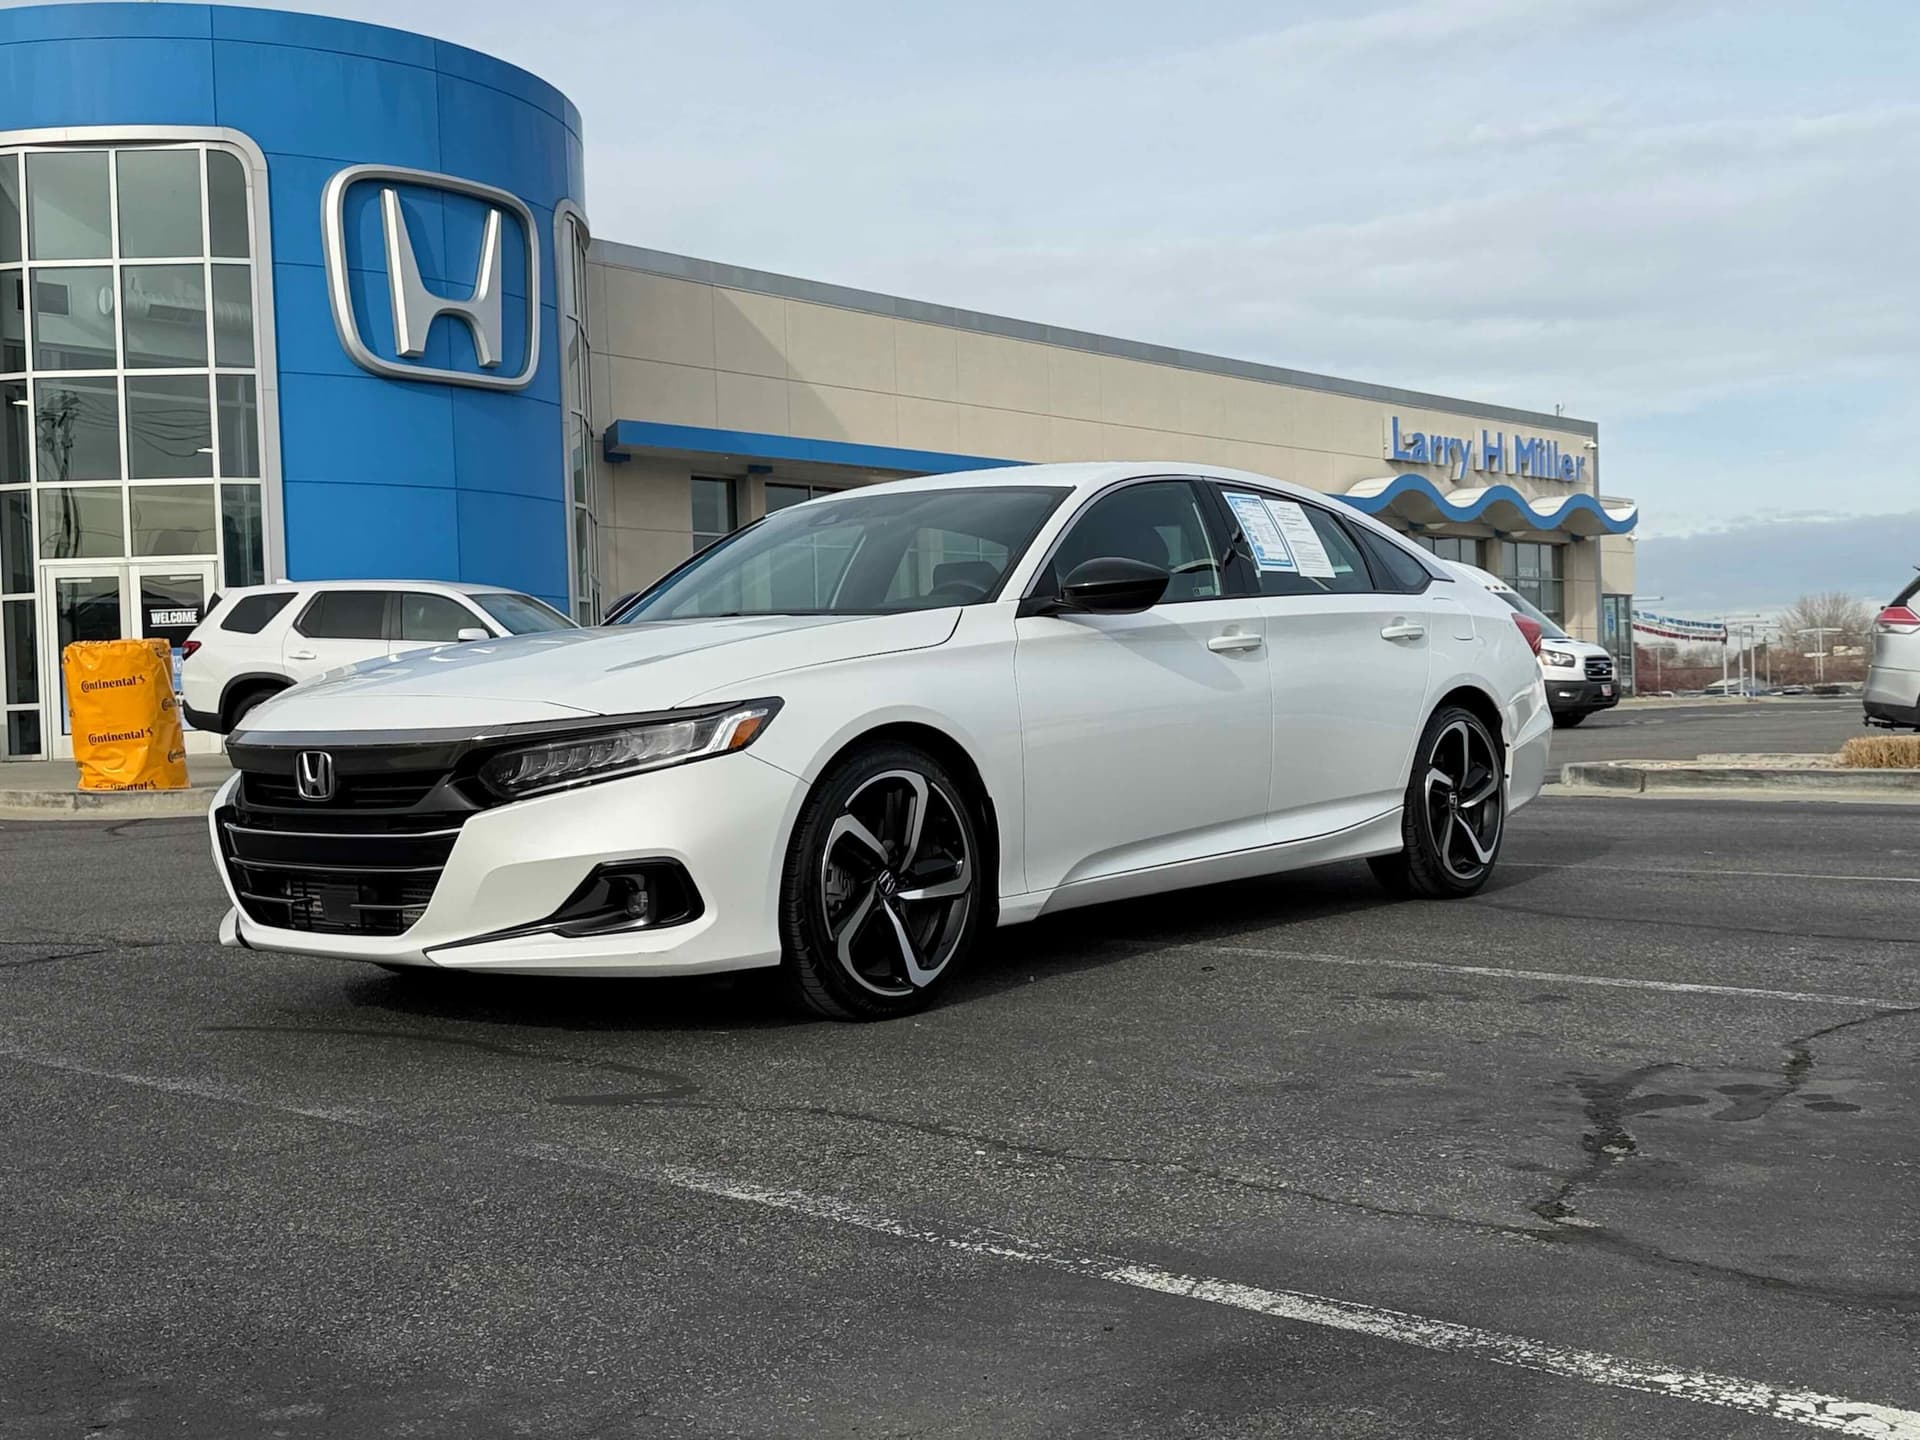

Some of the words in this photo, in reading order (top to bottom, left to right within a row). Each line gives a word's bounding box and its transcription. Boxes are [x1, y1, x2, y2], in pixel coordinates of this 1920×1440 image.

[1385, 416, 1472, 480] Larry
[1477, 429, 1504, 472] H
[1511, 434, 1586, 482] Miller
[151, 611, 198, 624] WELCOME
[81, 675, 137, 693] Continental
[88, 729, 145, 746] Continental
